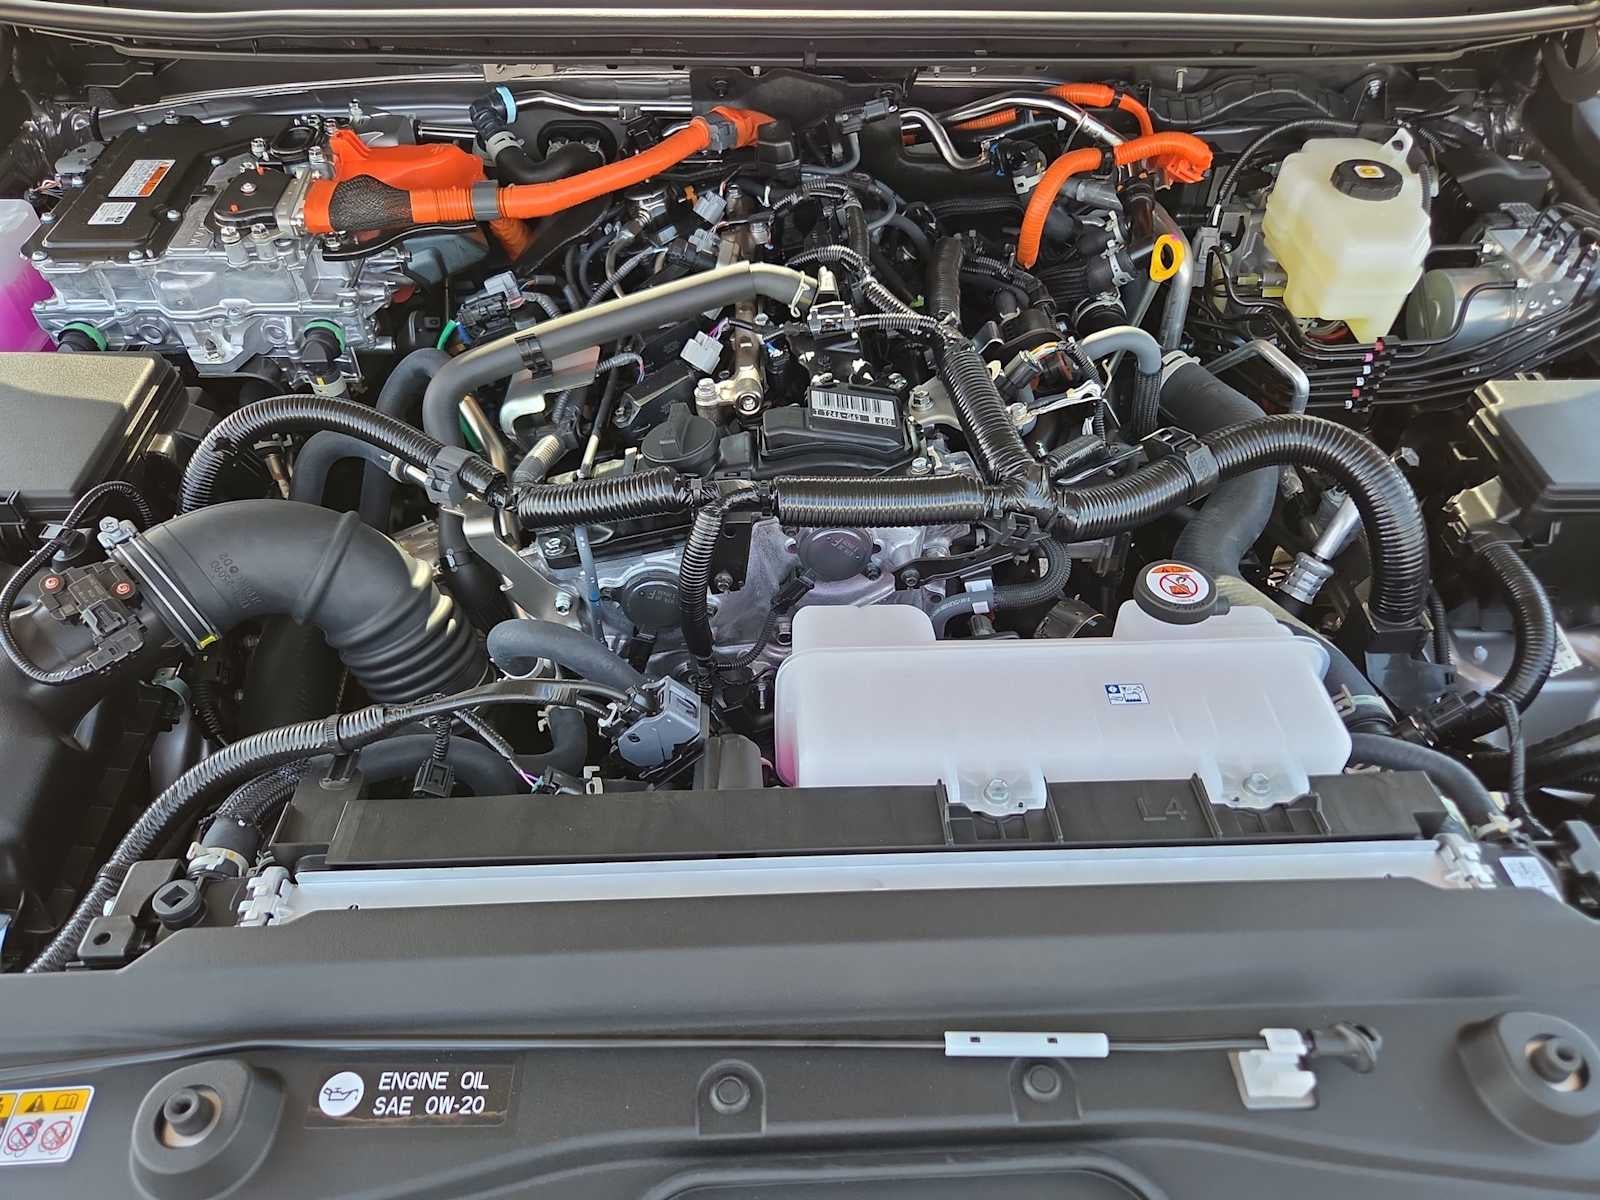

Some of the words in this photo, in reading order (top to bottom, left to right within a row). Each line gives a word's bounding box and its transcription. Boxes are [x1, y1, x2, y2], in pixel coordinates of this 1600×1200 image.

[1136, 797, 1188, 821] L4
[378, 1071, 449, 1090] ENGINE
[460, 1071, 489, 1090] OIL
[373, 1096, 414, 1115] SAE
[425, 1096, 485, 1115] 0W-20
